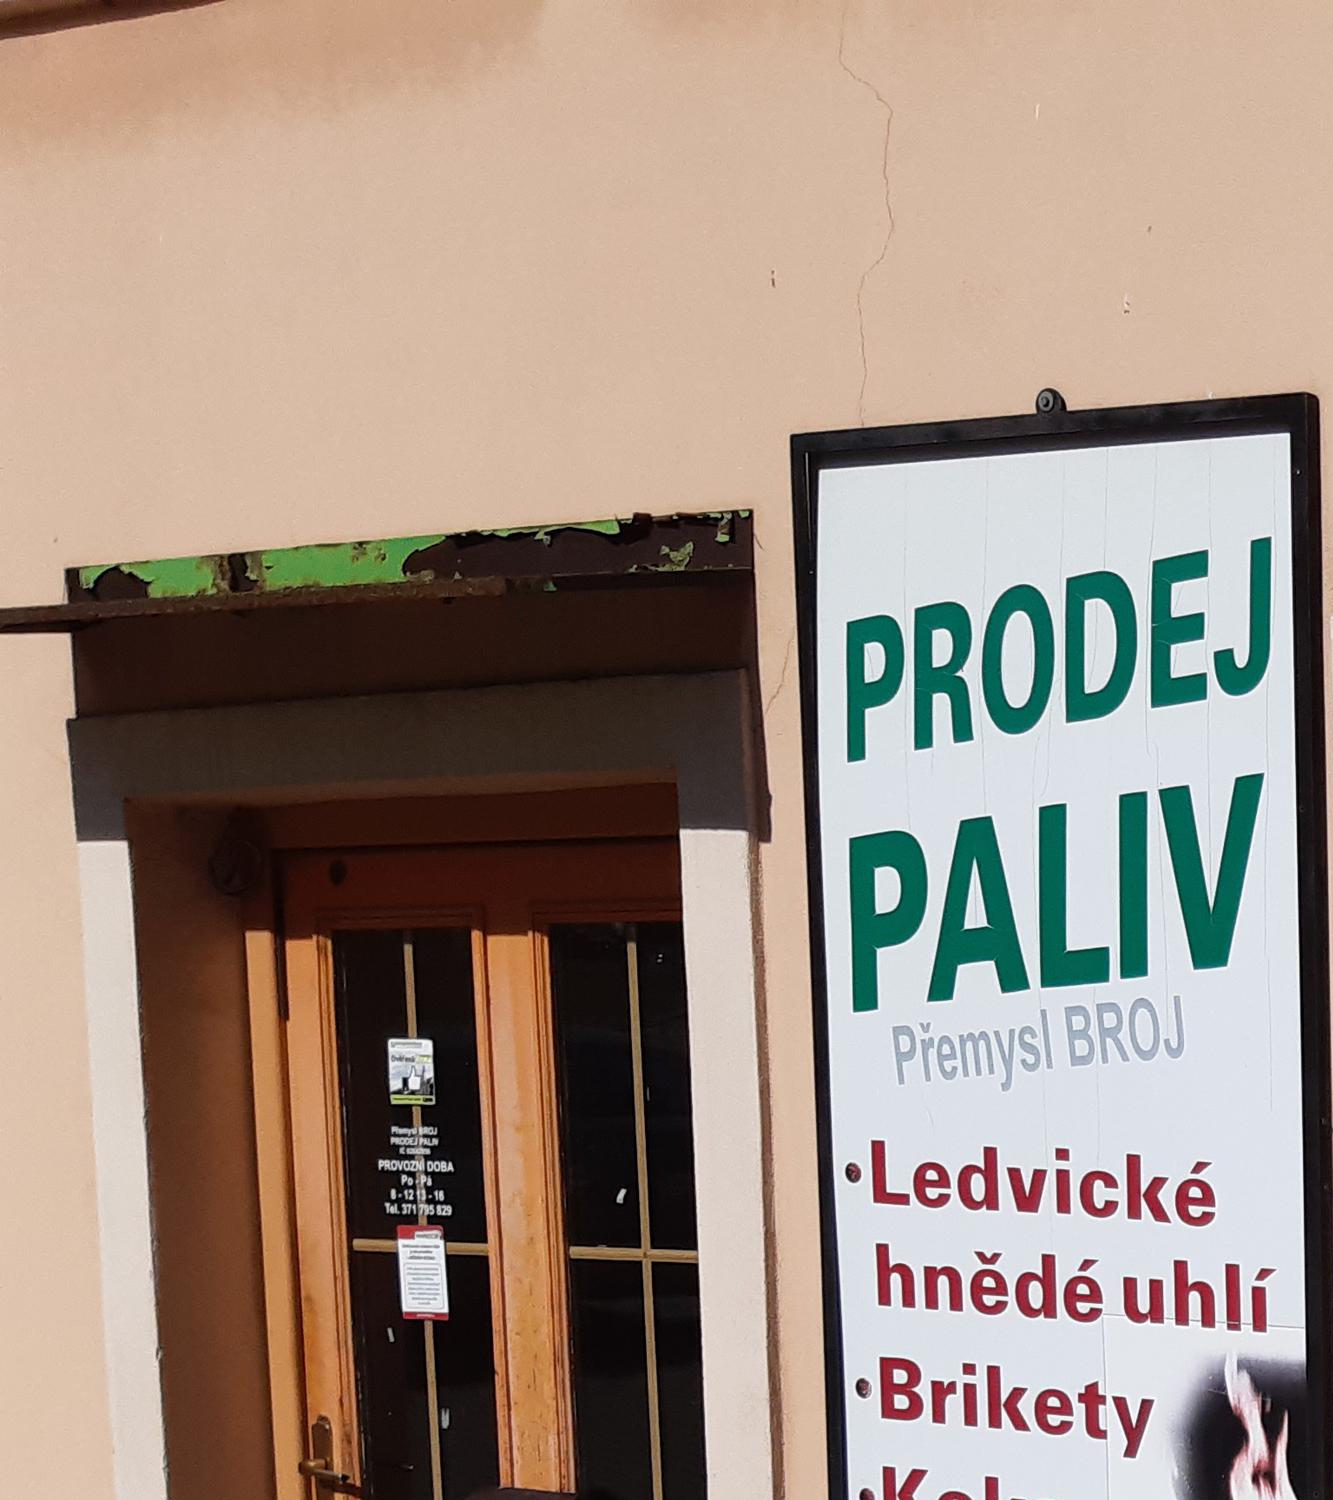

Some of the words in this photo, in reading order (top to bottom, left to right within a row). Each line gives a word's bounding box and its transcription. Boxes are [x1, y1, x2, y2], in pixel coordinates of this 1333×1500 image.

[846, 536, 1272, 763] PRODEJ
[848, 772, 1265, 1013] PALIV
[891, 1007, 1053, 1092] Přemysl
[1067, 995, 1186, 1067] BROJ
[378, 1159, 425, 1172] PROVOZNÍ
[427, 1161, 454, 1172] DOBA
[384, 1202, 400, 1214] Tel.
[402, 1204, 416, 1215] 371
[401, 1174, 413, 1186] Po
[421, 1174, 432, 1186] Pá
[404, 1189, 414, 1200] 12
[869, 1139, 1218, 1227] Ledvické
[875, 1242, 1104, 1324] hnědé
[1122, 1259, 1278, 1334] uhlí
[878, 1355, 1155, 1460] Brikety
